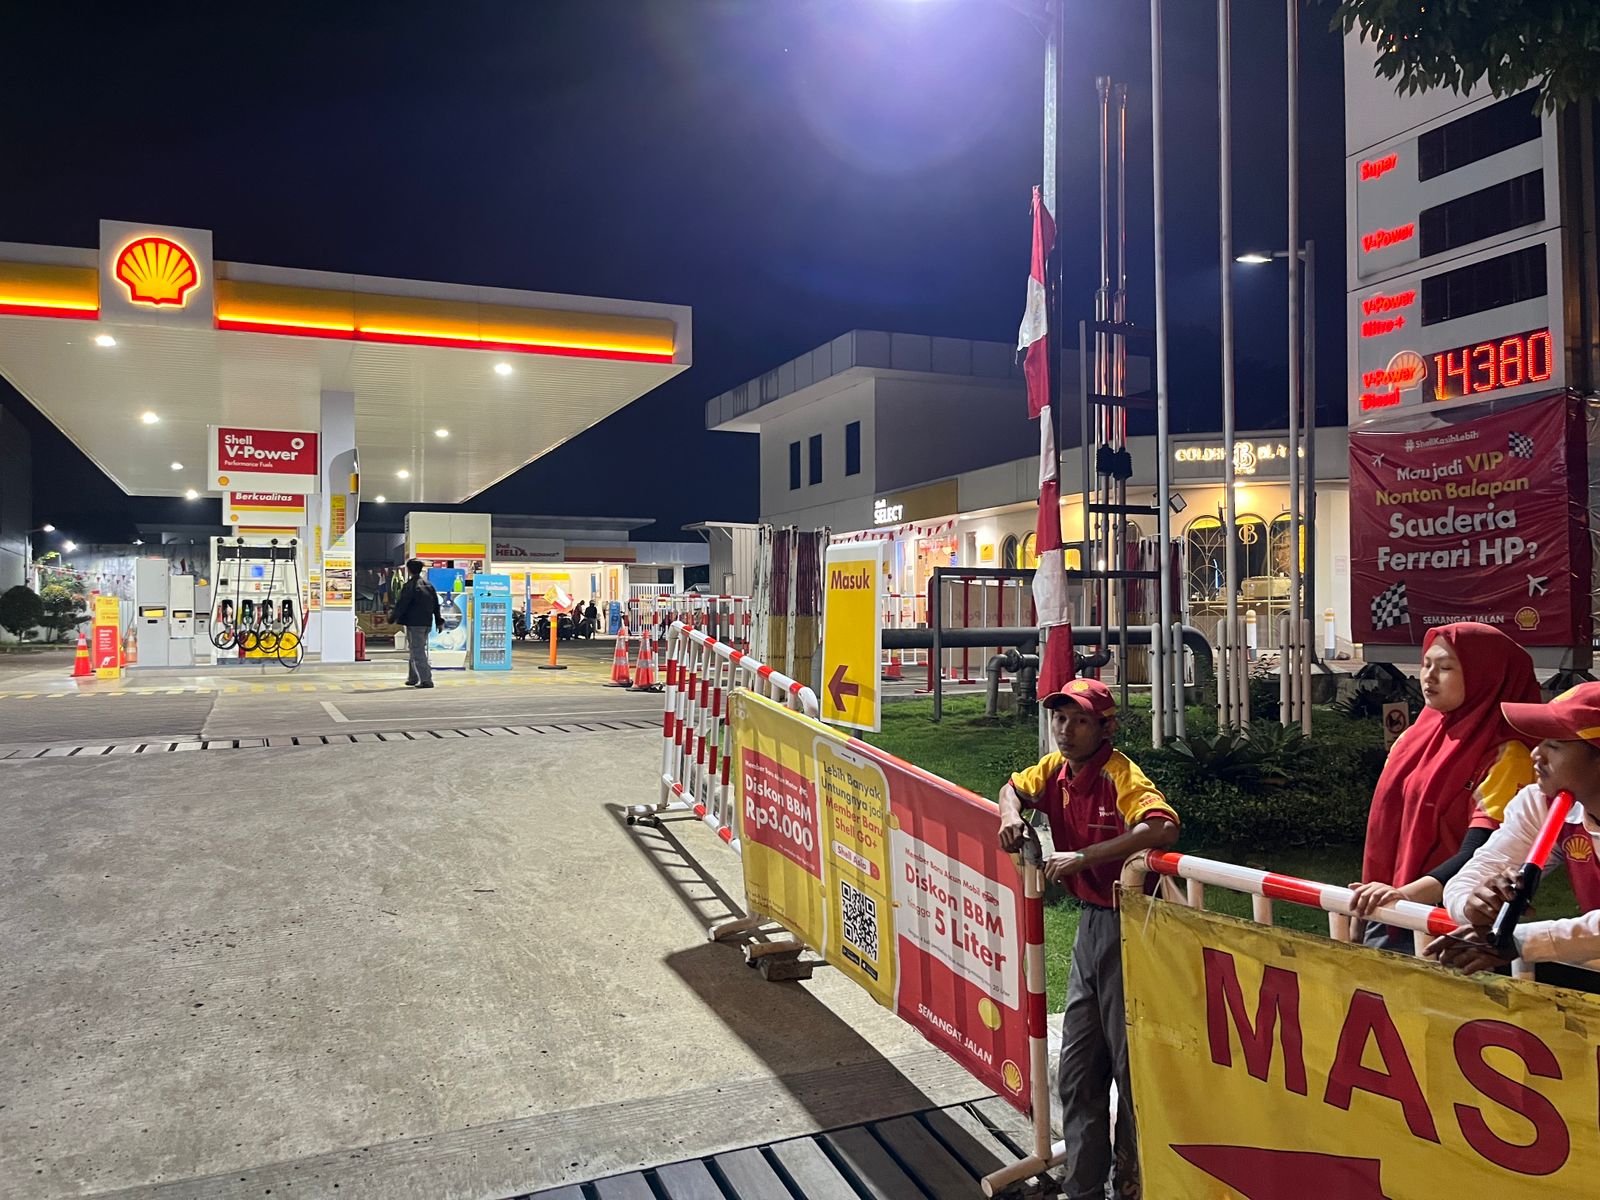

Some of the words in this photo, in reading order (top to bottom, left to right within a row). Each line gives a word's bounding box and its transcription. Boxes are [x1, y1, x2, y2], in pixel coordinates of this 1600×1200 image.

[1360, 153, 1397, 181] Super
[1361, 223, 1414, 254] V-Power
[1362, 290, 1416, 316] V-Power
[1362, 367, 1416, 388] V-Power
[1434, 331, 1552, 400] 14380
[224, 434, 253, 445] Shell
[224, 445, 299, 461] V-Power
[1404, 430, 1479, 453] #ShellKasihLebih
[224, 460, 258, 468] Performance
[1397, 467, 1430, 481] Mau
[1432, 459, 1463, 482] jadi
[1465, 450, 1504, 473] VIP
[235, 492, 293, 502] Berkualitas
[1375, 487, 1442, 506] Nonton
[1445, 477, 1530, 499] Balapan
[874, 504, 904, 524] SELECT
[1388, 502, 1517, 538] Scuderia
[495, 549, 528, 557] HELIX
[1377, 539, 1471, 572] Ferrari
[830, 567, 871, 590] Masuk
[1422, 615, 1472, 625] SEMANGAT
[821, 775, 868, 810] Untungnya
[823, 760, 846, 782] Lebih
[847, 772, 881, 800] Banyak
[745, 773, 785, 807] Diskon
[786, 794, 812, 824] BBM
[745, 795, 814, 852] Rp3.000
[825, 795, 861, 824] Member
[862, 815, 884, 839] Baru
[835, 816, 856, 838] Shell
[856, 830, 878, 849] GO+
[904, 847, 929, 866] Member
[930, 860, 943, 875] Baru
[944, 870, 962, 885] Akun
[963, 879, 981, 897] Mobil
[904, 862, 958, 912] Diskon
[963, 895, 1004, 938] BBM
[934, 906, 946, 936] 5
[951, 917, 1007, 973] Liter
[917, 1002, 963, 1042] SEMANGAT
[964, 1037, 993, 1065] JALAN
[1203, 946, 1600, 1176] MAS
